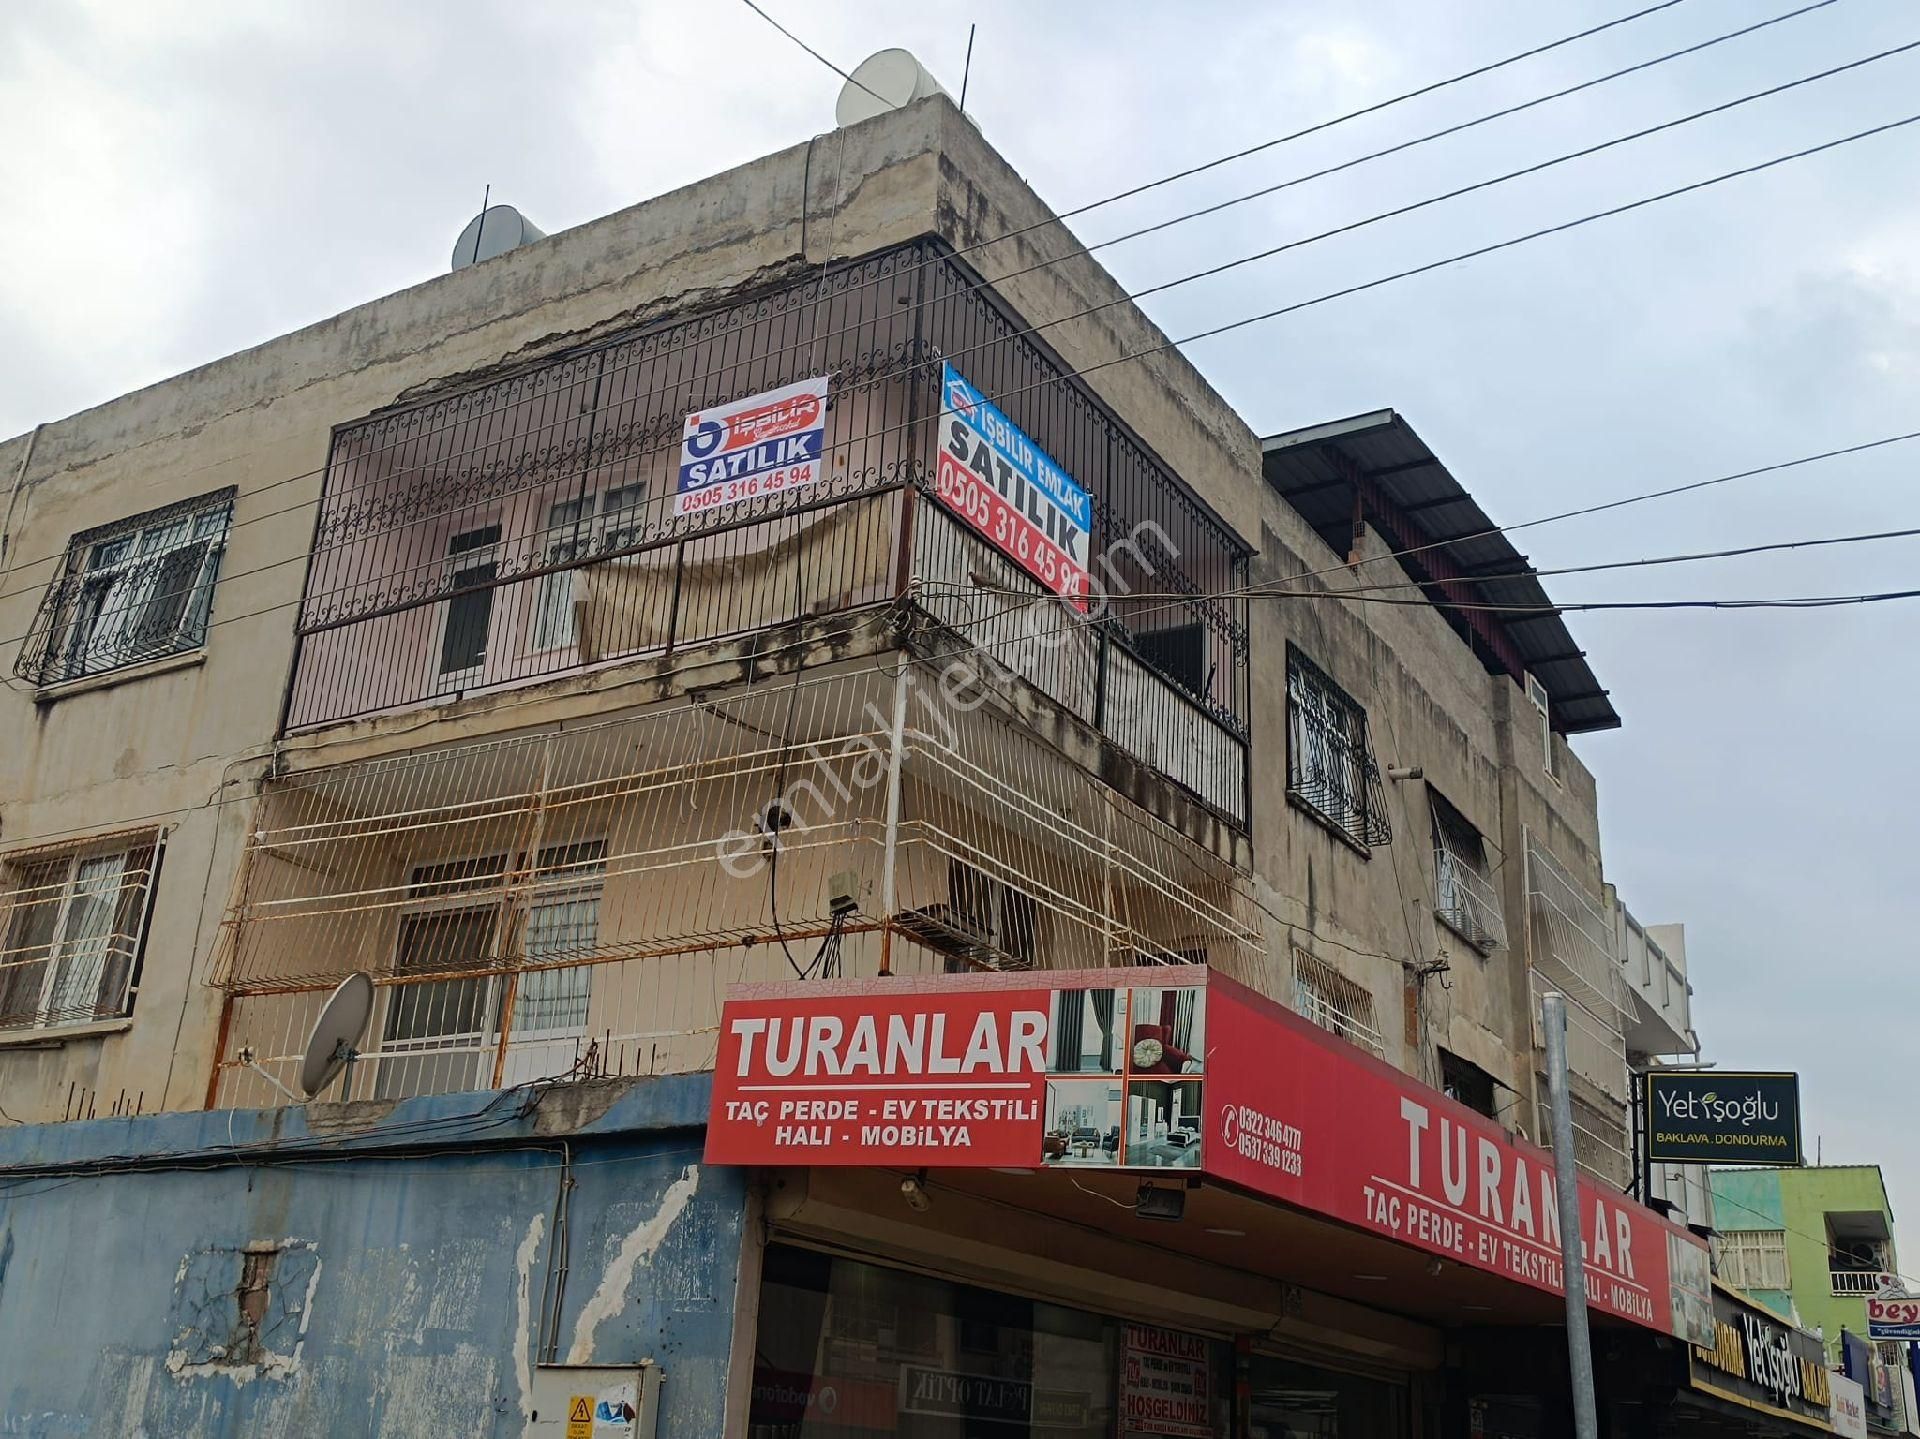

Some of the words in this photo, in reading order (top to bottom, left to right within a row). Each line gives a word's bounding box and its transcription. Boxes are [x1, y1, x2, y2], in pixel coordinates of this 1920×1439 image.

[687, 435, 812, 488] SATILIK
[982, 399, 1033, 475] İŞBİLİR
[1037, 459, 1083, 520] EMLAK
[682, 486, 722, 512] 0505
[727, 478, 758, 500] 316
[763, 471, 784, 490] 45
[789, 464, 812, 485] 94
[950, 421, 1078, 560] SATILIK
[939, 460, 988, 526] 0505
[995, 507, 1029, 559] 316
[1034, 540, 1056, 582] 45
[1060, 562, 1081, 597] 94
[731, 1010, 1048, 1077] TURANLAR
[726, 1101, 769, 1126] TAÇ
[779, 1100, 859, 1120] PERDE
[882, 1100, 918, 1120] EV
[1239, 1105, 1263, 1136] 0322
[1265, 1117, 1282, 1143] 346
[1658, 1090, 1778, 1126] Yetişoğlu
[775, 1126, 832, 1146] HALI
[1238, 1132, 1262, 1161] 0537
[1263, 1141, 1280, 1168] 339
[1282, 1150, 1302, 1177] 1233
[1656, 1132, 1709, 1144] BAKLAVA
[1715, 1134, 1787, 1146] DONDURMA
[1400, 1096, 1635, 1279] TURANAR
[1364, 1186, 1401, 1235] TAÇ
[1407, 1203, 1463, 1253] PERDE
[1478, 1232, 1498, 1265] EV
[1128, 1325, 1205, 1358] TURANLAR
[1696, 1317, 1746, 1379] DURMA
